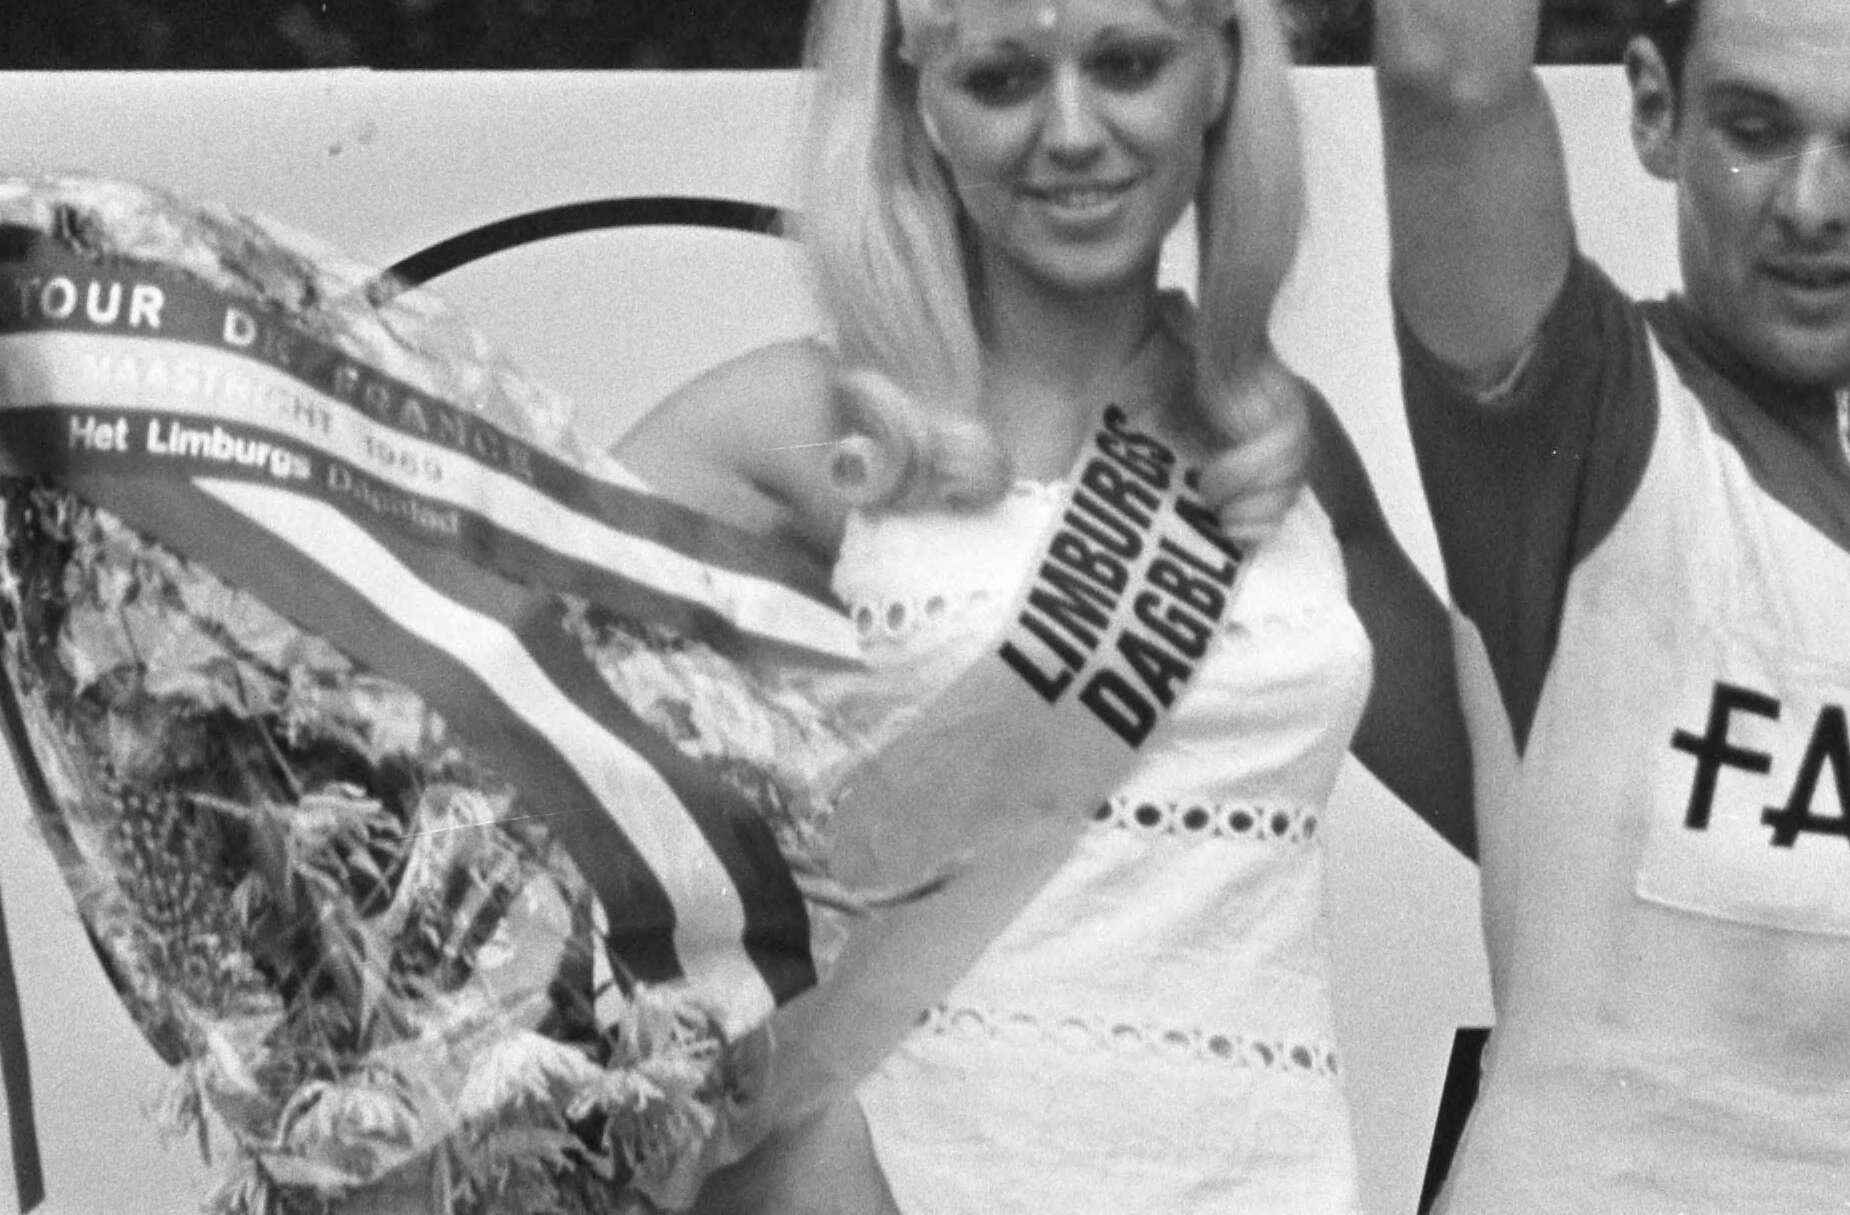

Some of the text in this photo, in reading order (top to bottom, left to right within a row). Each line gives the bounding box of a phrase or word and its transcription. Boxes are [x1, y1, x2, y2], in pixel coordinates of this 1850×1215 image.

[16, 276, 165, 327] TOUR
[68, 414, 129, 453] Het
[1079, 467, 1244, 749] DAGBLA
